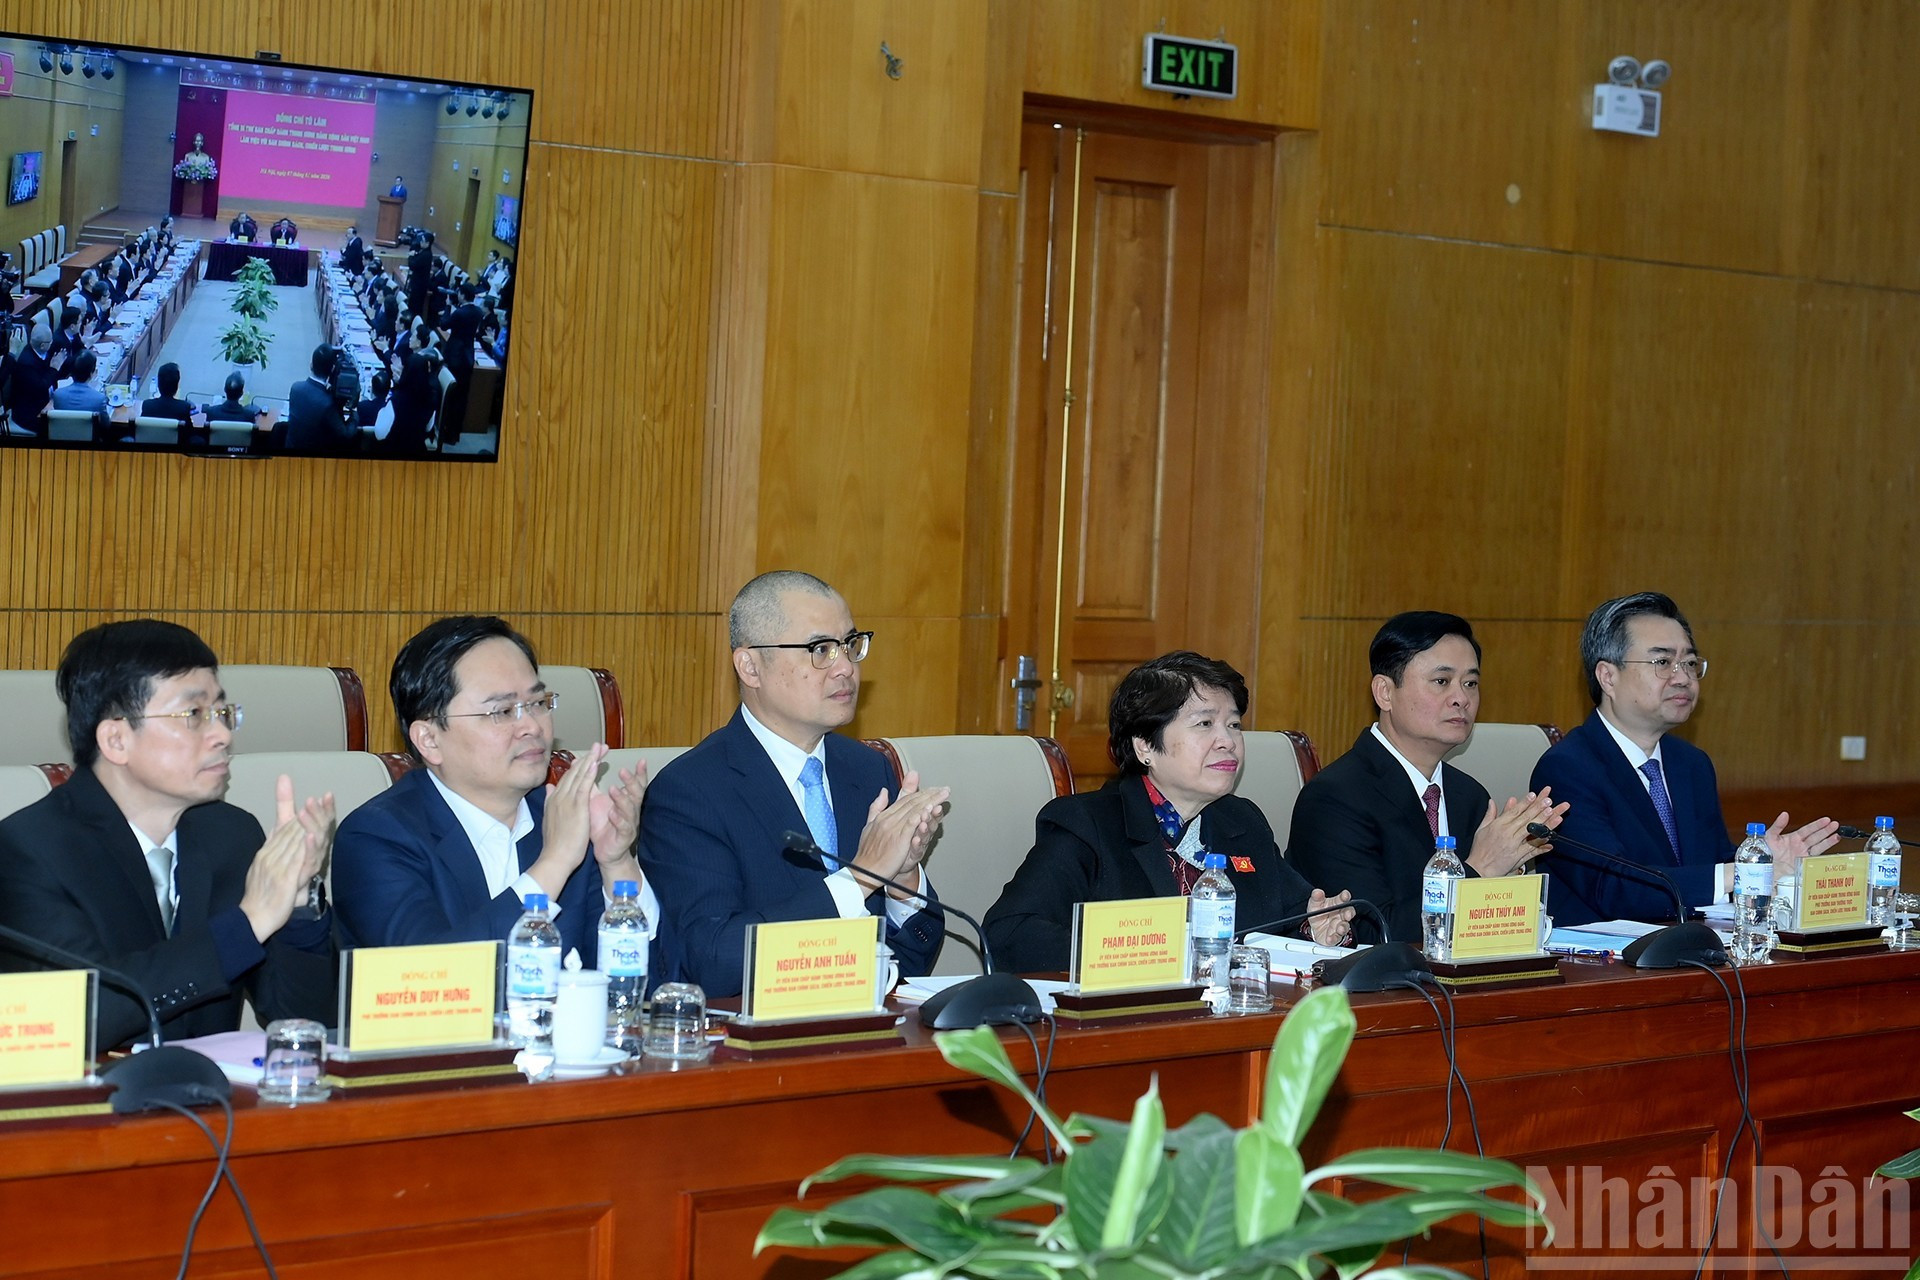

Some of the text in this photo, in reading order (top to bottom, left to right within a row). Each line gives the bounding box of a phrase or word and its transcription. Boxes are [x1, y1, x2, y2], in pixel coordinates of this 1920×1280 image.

[1160, 45, 1224, 87] EXIT
[1816, 877, 1826, 889] THÁI
[1828, 878, 1843, 888] THANH
[1485, 890, 1512, 901] ĐỒNG CHÍ
[1469, 904, 1525, 920] NGUYỄN THÚY ANH
[1119, 916, 1152, 928] ĐỒNG CHÍ
[799, 936, 837, 948] ĐỒNG CHÍ
[1102, 933, 1166, 951] PHẠM ĐẠI DƯƠNG
[776, 949, 856, 972] NGUYỄN ANH TUẤN
[376, 986, 470, 1005] NGUYỄN DUY HƯNG
[18, 1022, 53, 1037] TRUNG
